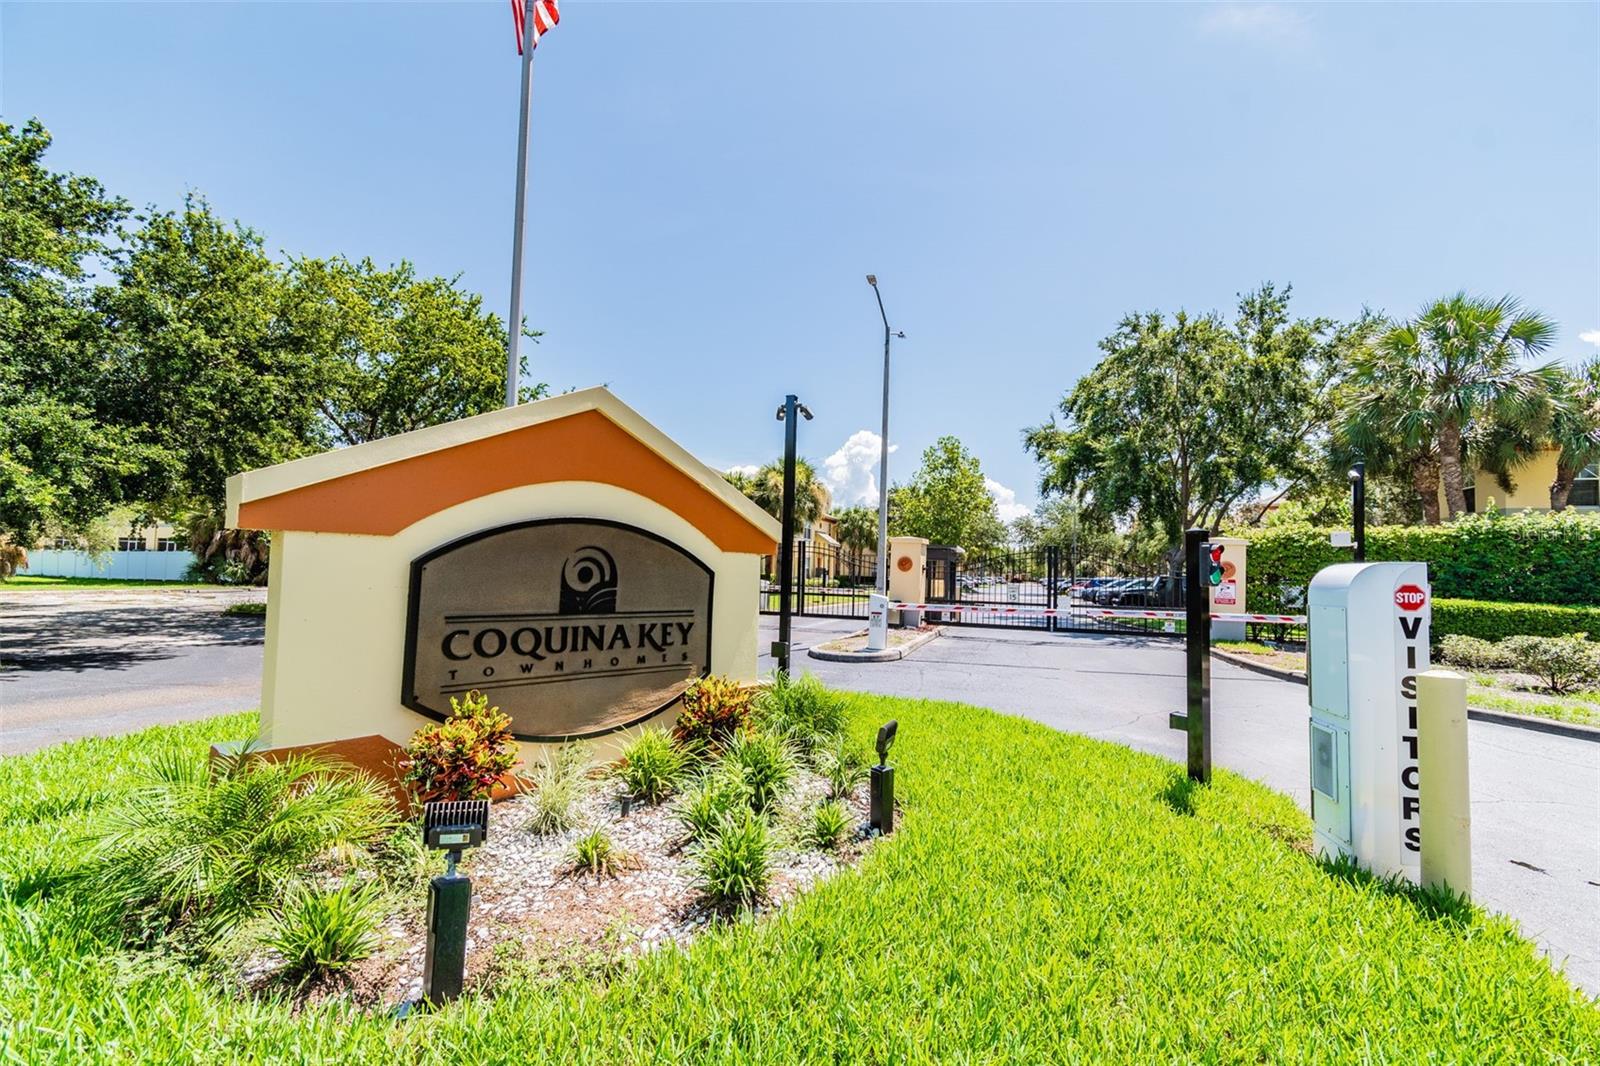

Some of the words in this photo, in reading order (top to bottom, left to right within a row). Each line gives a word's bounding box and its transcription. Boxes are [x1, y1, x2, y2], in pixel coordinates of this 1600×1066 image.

[1396, 592, 1424, 604] STOP
[441, 624, 631, 661] COQUINA
[638, 622, 694, 651] KEY
[448, 652, 688, 680] TOWNHOMES
[1399, 616, 1422, 852] VISITORS
